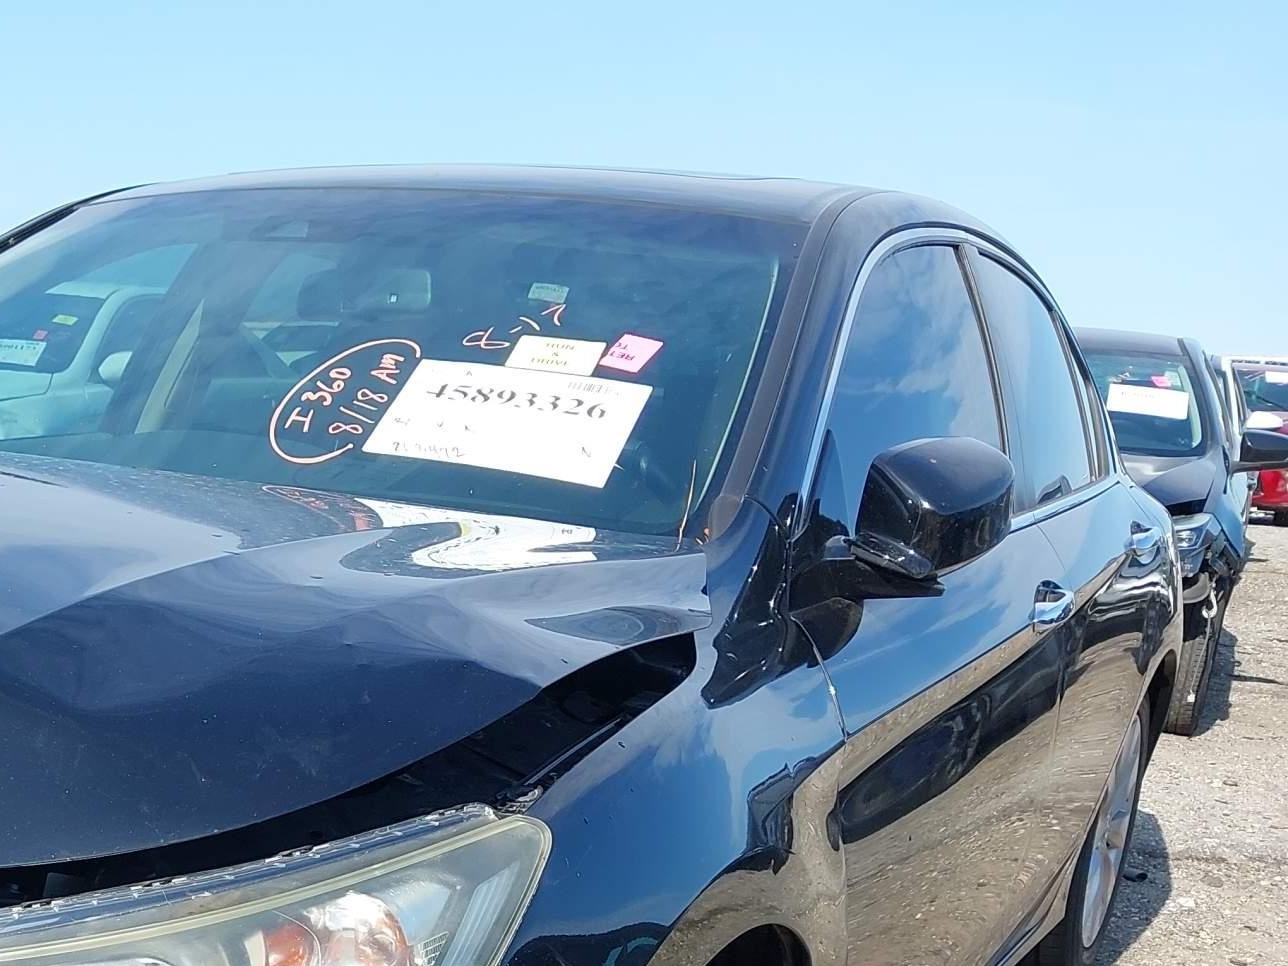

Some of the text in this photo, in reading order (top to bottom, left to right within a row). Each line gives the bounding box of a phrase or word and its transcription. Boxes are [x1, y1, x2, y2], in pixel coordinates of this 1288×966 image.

[301, 367, 352, 406] 360
[328, 353, 405, 435] 8/18 AM
[426, 383, 606, 419] 45893326
